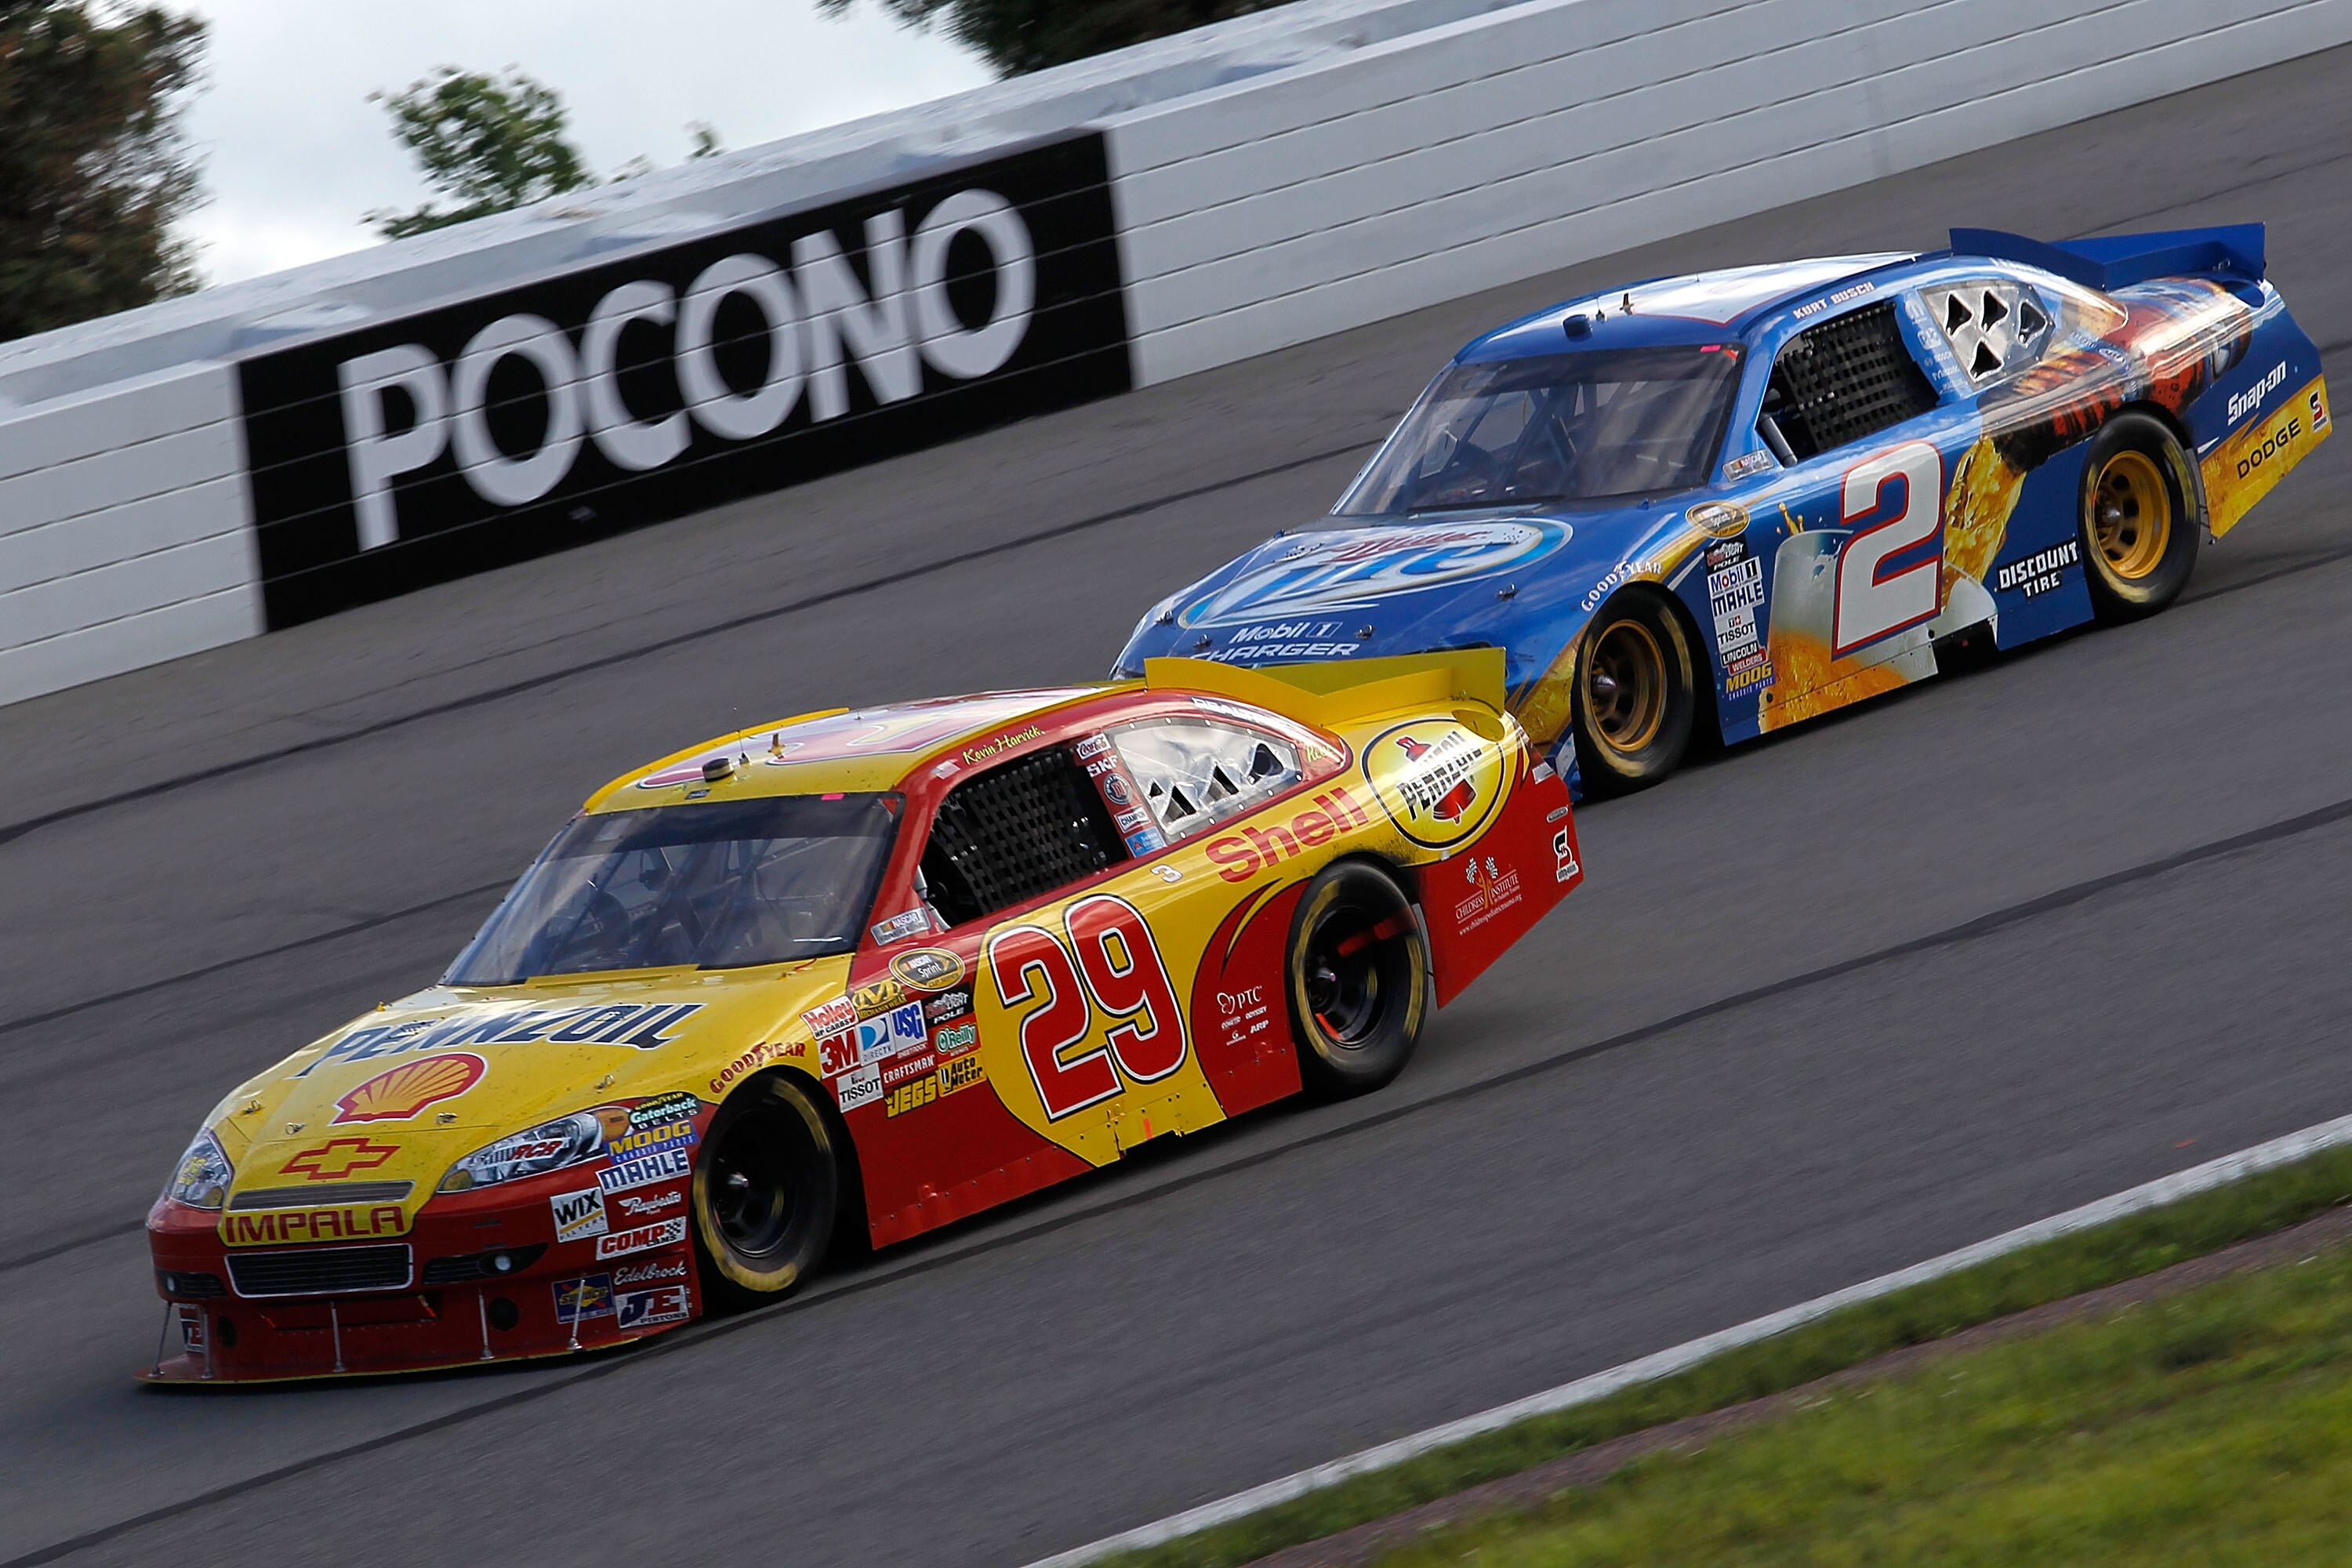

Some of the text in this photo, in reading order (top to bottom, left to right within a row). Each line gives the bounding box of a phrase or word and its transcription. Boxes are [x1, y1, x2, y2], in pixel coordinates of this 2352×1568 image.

[1792, 281, 1875, 319] KURT BUSCH
[339, 187, 1036, 553] POCONO
[2227, 360, 2286, 426] Snap-on
[2237, 417, 2302, 480] DODGE
[1713, 556, 1740, 571] POLE
[1831, 439, 1945, 662] 2
[1998, 541, 2078, 589] DISCOUNT
[1581, 560, 1661, 612] GOODYEAR
[1710, 564, 1744, 593] Mobil
[2023, 572, 2060, 597] TIRE
[1711, 581, 1763, 617] MAHLE
[1229, 622, 1311, 644] Mobil
[1718, 622, 1755, 645] TISSOT
[1722, 642, 1758, 665] LINCOLN
[1732, 653, 1762, 672] WELDERS
[1726, 662, 1772, 694] MOOG
[962, 724, 1042, 765] Kevin Harvick
[1086, 754, 1118, 778] SKF
[1205, 786, 1370, 883] Shell
[1150, 863, 1184, 884] 3
[917, 962, 942, 978] Sprint
[987, 892, 1189, 1124] 29
[1236, 985, 1262, 1009] PTC
[802, 1000, 856, 1031] Holley
[826, 1018, 850, 1033] CARBS
[892, 1004, 924, 1040] USG
[933, 1007, 965, 1024] POLE
[1250, 1019, 1269, 1034] ARP
[285, 1003, 707, 1079] PENNZOIL
[820, 1029, 859, 1074] 3M
[936, 1024, 976, 1052] O'Reilly
[709, 1041, 806, 1094] GOODYEAR
[883, 1055, 933, 1083] CRAFTSMAN
[839, 1077, 880, 1103] TISSOT
[887, 1075, 937, 1118] JEGS
[630, 1098, 697, 1123] Gatorback
[637, 1109, 698, 1130] BELTS
[507, 1140, 564, 1162] RCR
[609, 1120, 691, 1156] MOOG
[615, 1135, 693, 1163] CHASSIS PARTS
[598, 1149, 689, 1190] MAHLE
[554, 1190, 601, 1226] WIX
[224, 1206, 406, 1244] IMPALA
[560, 1215, 605, 1241] FILTERS
[601, 1224, 666, 1254] COMP
[646, 1234, 677, 1247] CAMS
[613, 1258, 688, 1286] Edelbrock
[619, 1287, 681, 1326] JE
[640, 1312, 689, 1324] PISTONS
